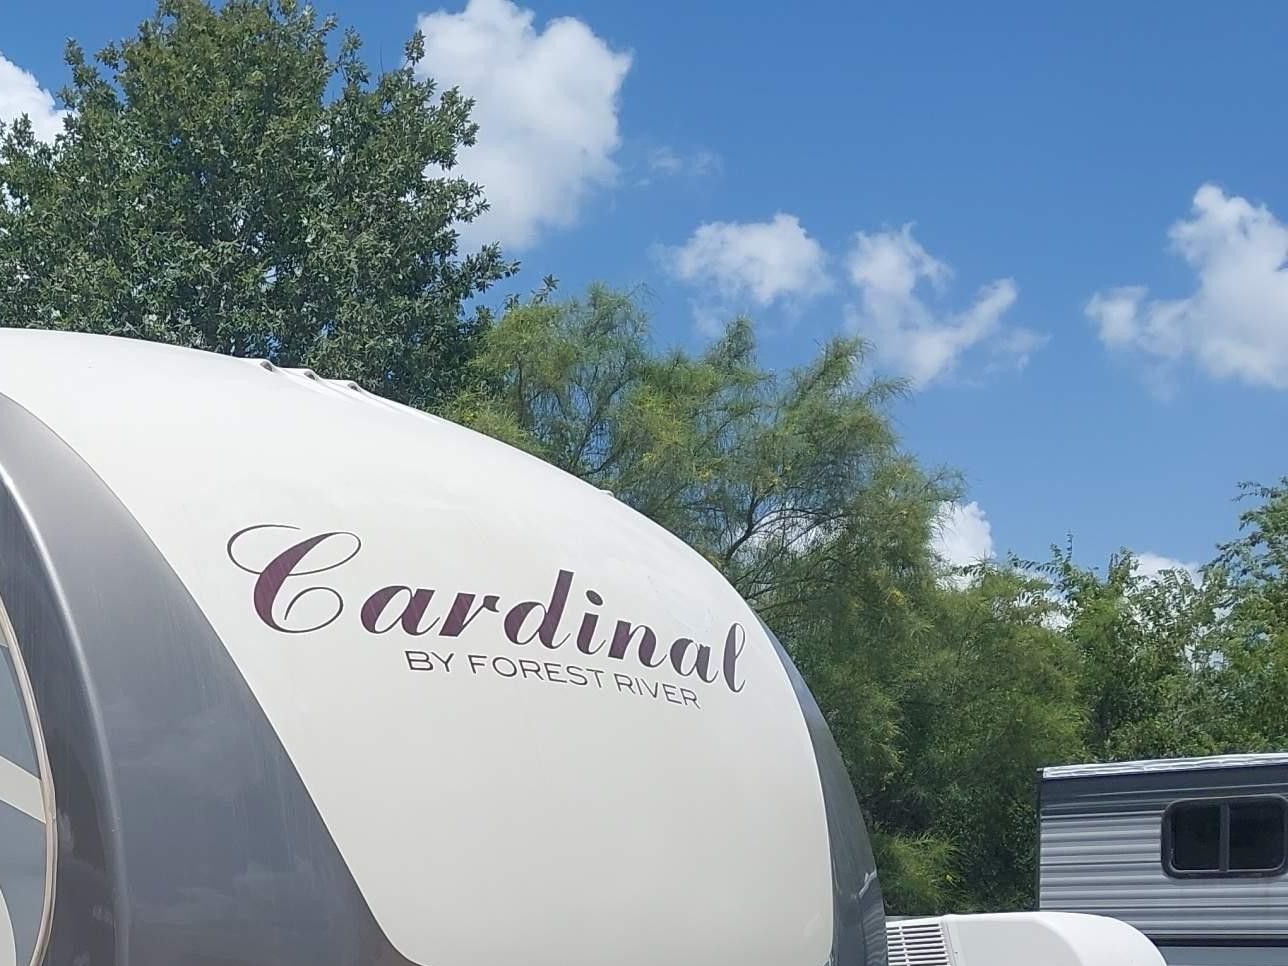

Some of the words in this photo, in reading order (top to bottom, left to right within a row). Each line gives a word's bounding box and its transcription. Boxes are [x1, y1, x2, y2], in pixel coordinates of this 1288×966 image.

[226, 523, 746, 693] Cardinal
[404, 649, 455, 673] BY
[467, 654, 606, 689] FOREST
[613, 674, 701, 709] RIVER
